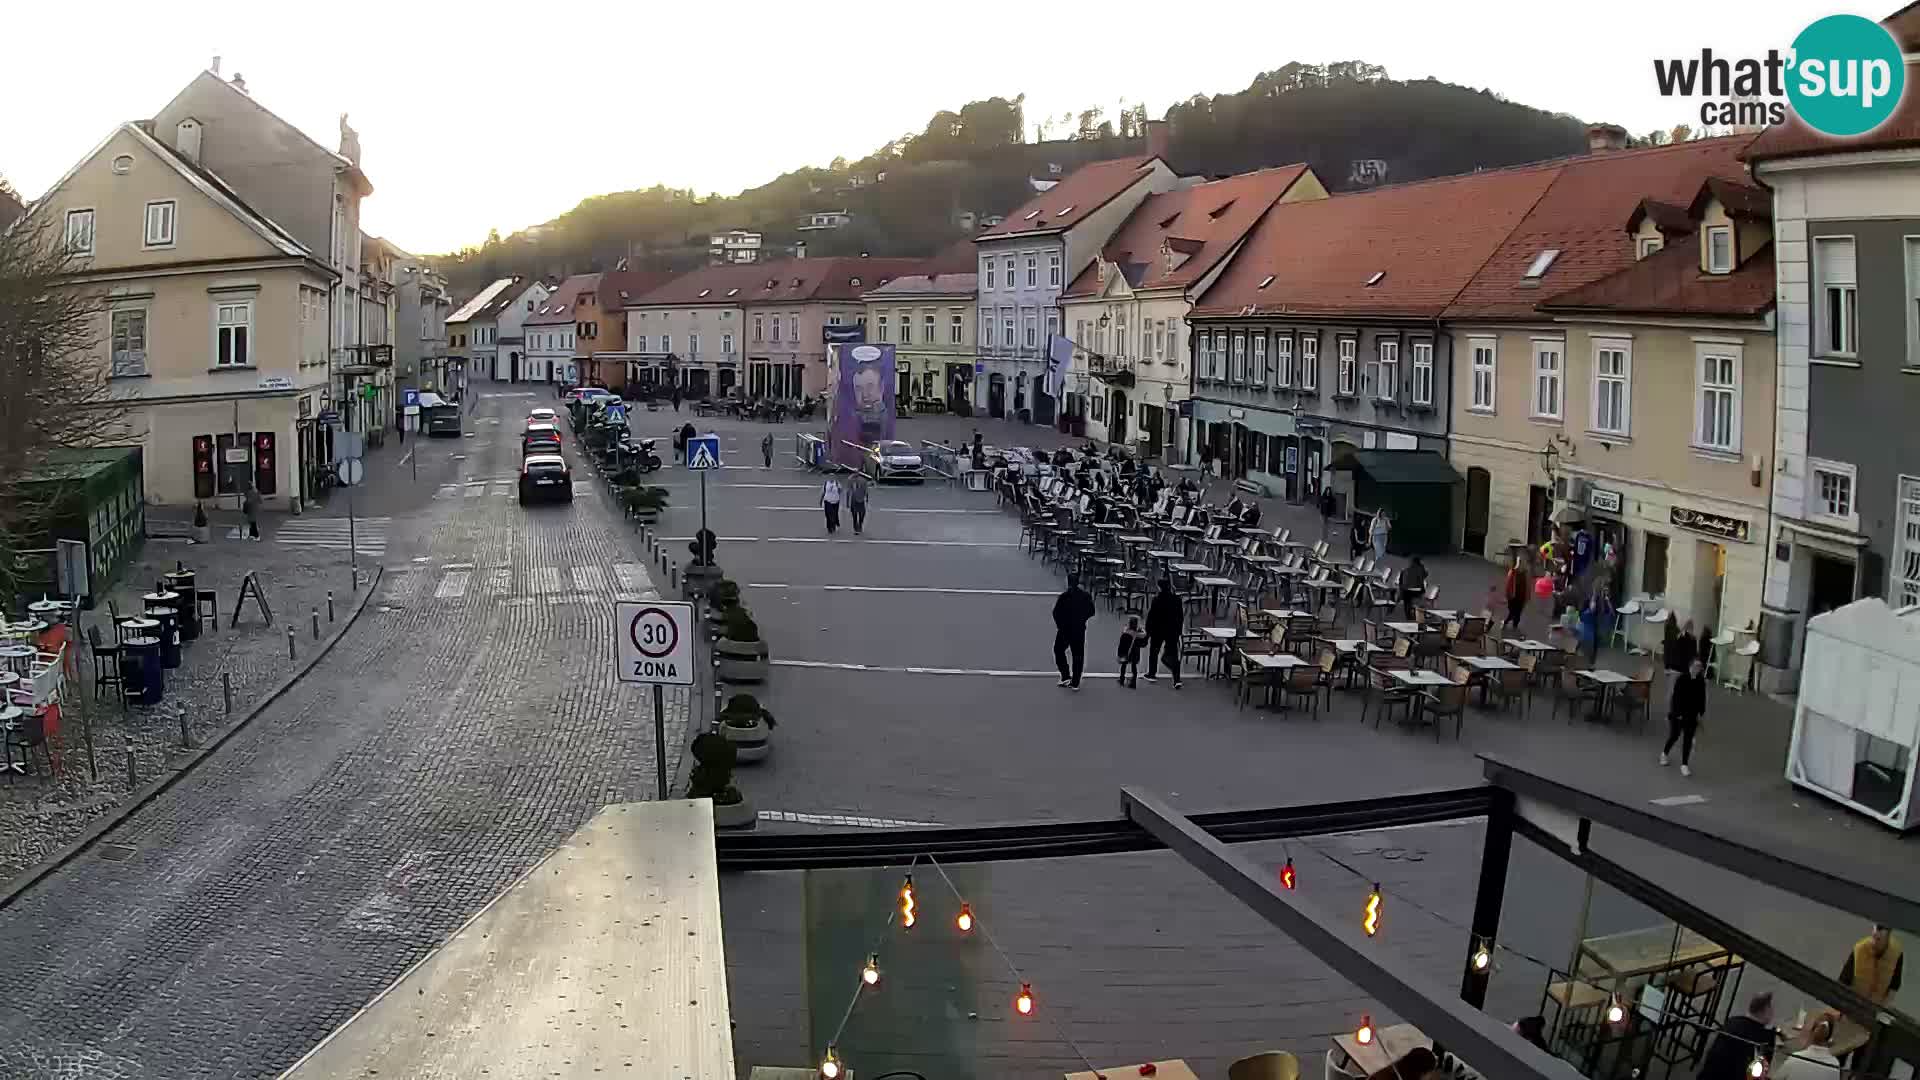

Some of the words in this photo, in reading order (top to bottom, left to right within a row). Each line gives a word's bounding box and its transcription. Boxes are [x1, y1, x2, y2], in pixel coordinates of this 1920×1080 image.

[407, 392, 415, 403] P
[643, 624, 667, 644] 30
[633, 661, 677, 677] ZONA
